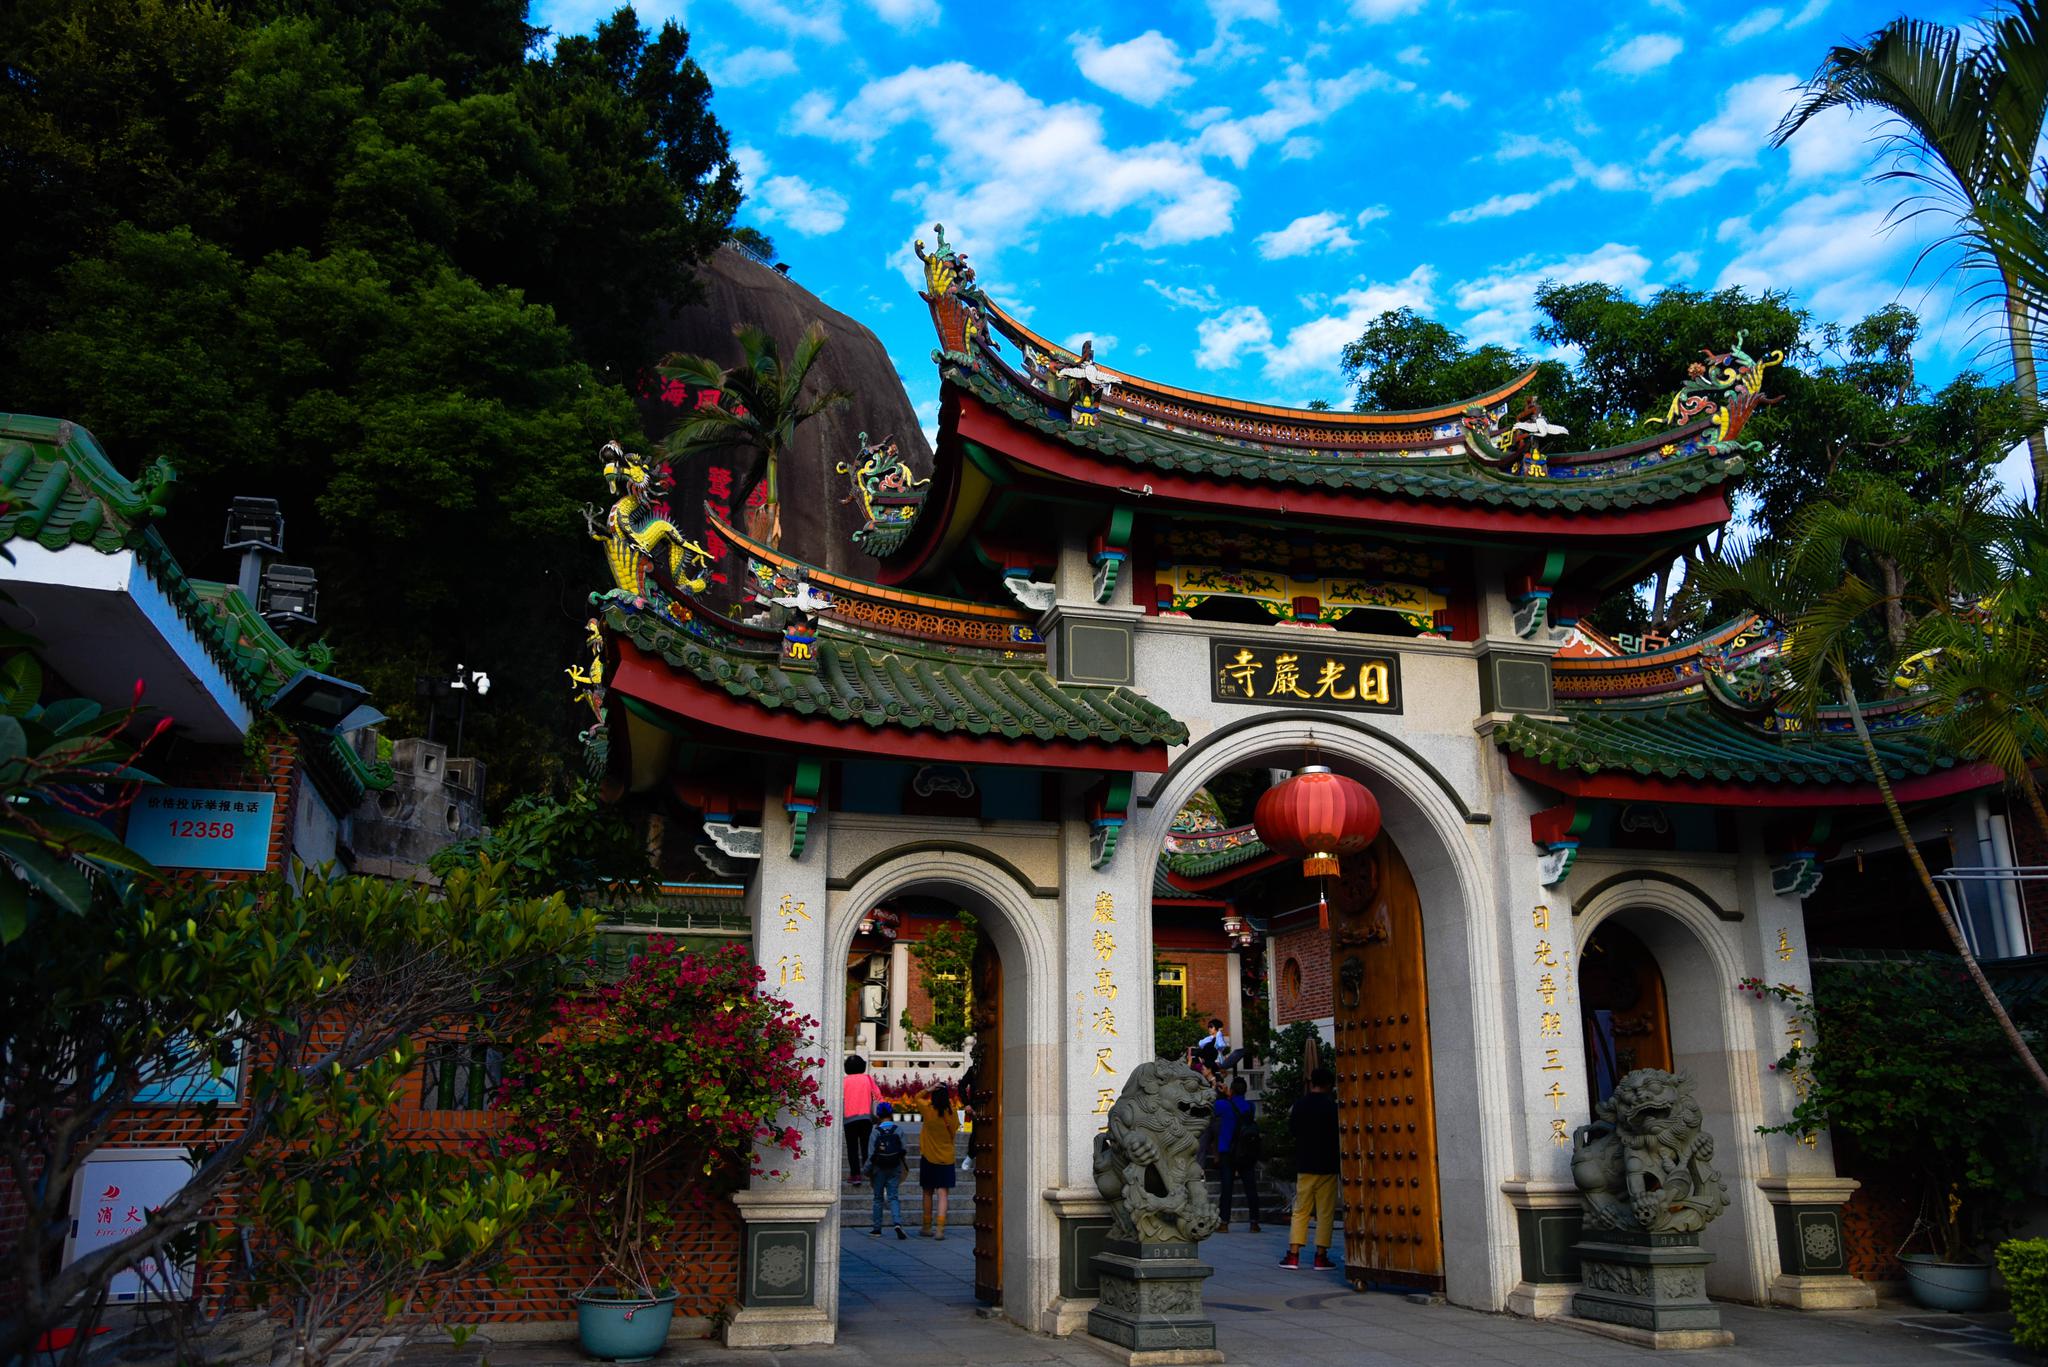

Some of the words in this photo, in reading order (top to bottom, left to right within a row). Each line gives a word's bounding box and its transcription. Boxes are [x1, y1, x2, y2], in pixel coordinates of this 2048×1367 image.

[148, 797, 260, 813] 价格投诉举报电话
[169, 820, 235, 839] 12358
[1532, 905, 1570, 1149] 日光普照三千界
[97, 1205, 162, 1224] 消火
